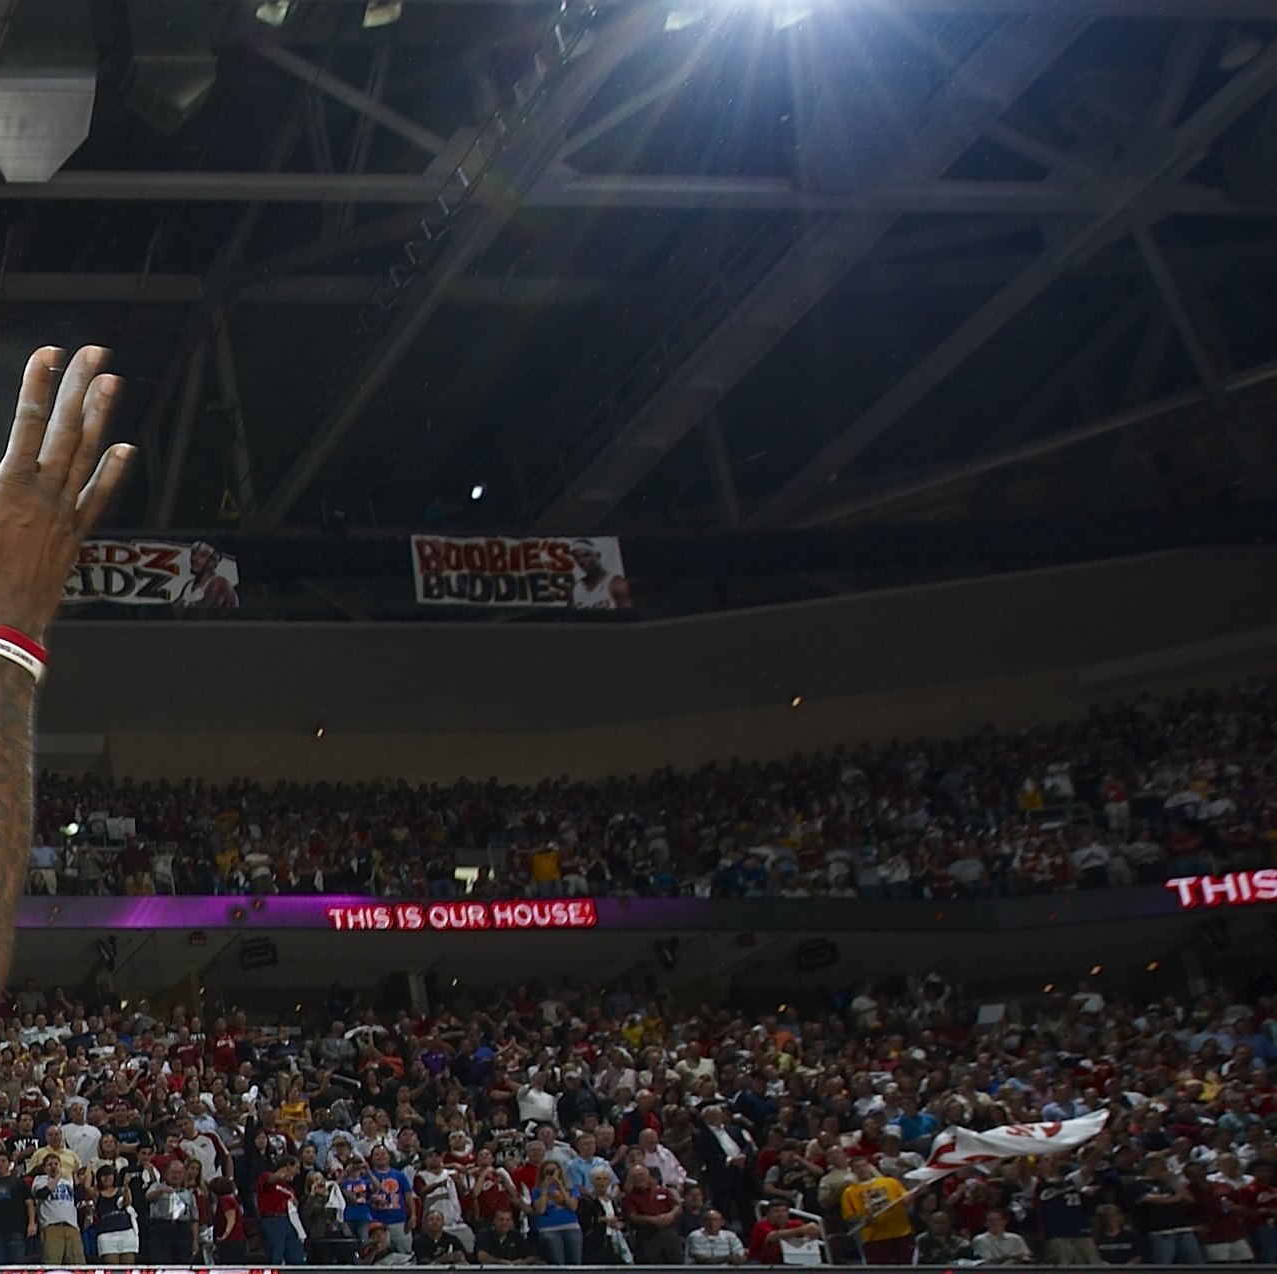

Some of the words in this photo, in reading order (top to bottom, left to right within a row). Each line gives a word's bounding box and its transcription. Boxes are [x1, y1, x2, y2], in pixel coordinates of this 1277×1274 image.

[78, 544, 182, 576] EDZ
[415, 538, 575, 575] BOOBIE'S
[421, 571, 575, 602] BUDDIES
[329, 907, 391, 930] THIS
[397, 905, 423, 929] IS
[429, 903, 487, 928] OUR
[493, 901, 596, 927] HOUSE!
